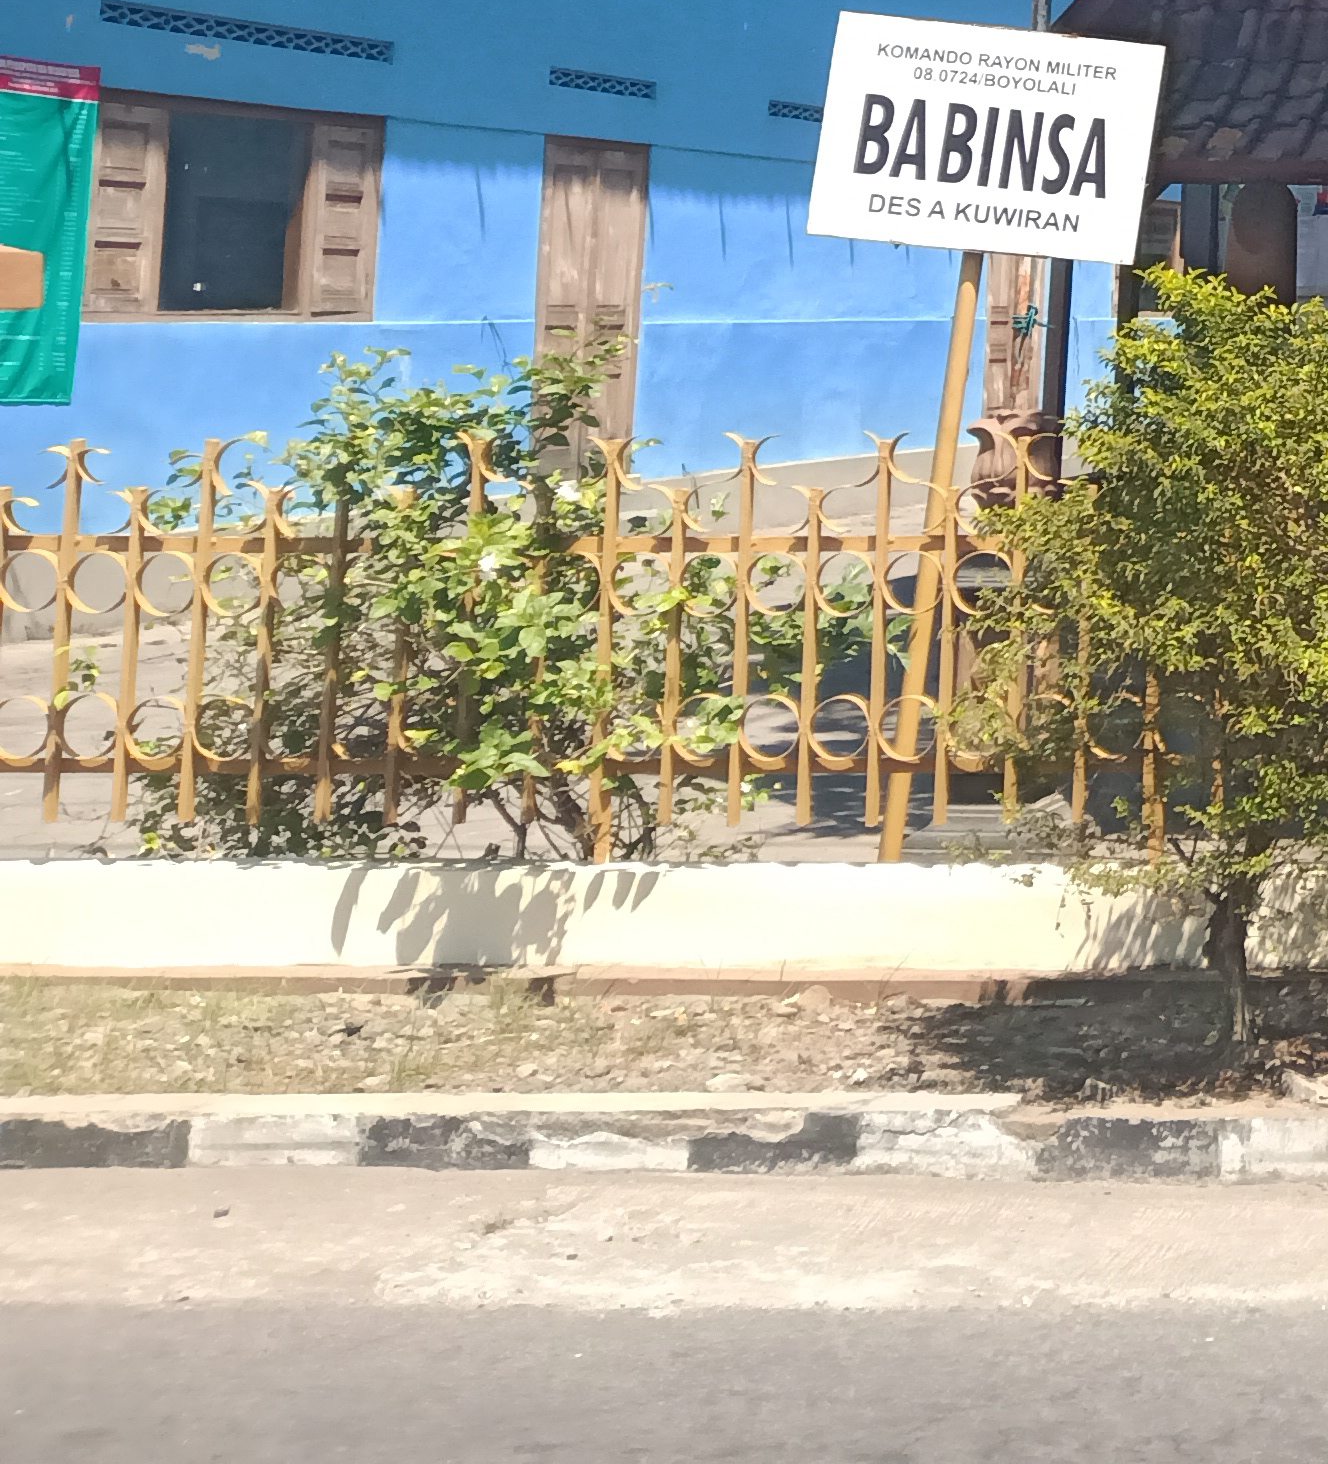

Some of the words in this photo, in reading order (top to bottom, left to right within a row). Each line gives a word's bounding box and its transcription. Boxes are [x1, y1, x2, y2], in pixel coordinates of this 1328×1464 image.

[877, 43, 972, 65] KOMANDO
[978, 53, 1040, 72] RAYON
[1046, 61, 1117, 80] MILITER
[853, 93, 1106, 199] BABINSA
[954, 202, 1079, 232] KUWIRAN
